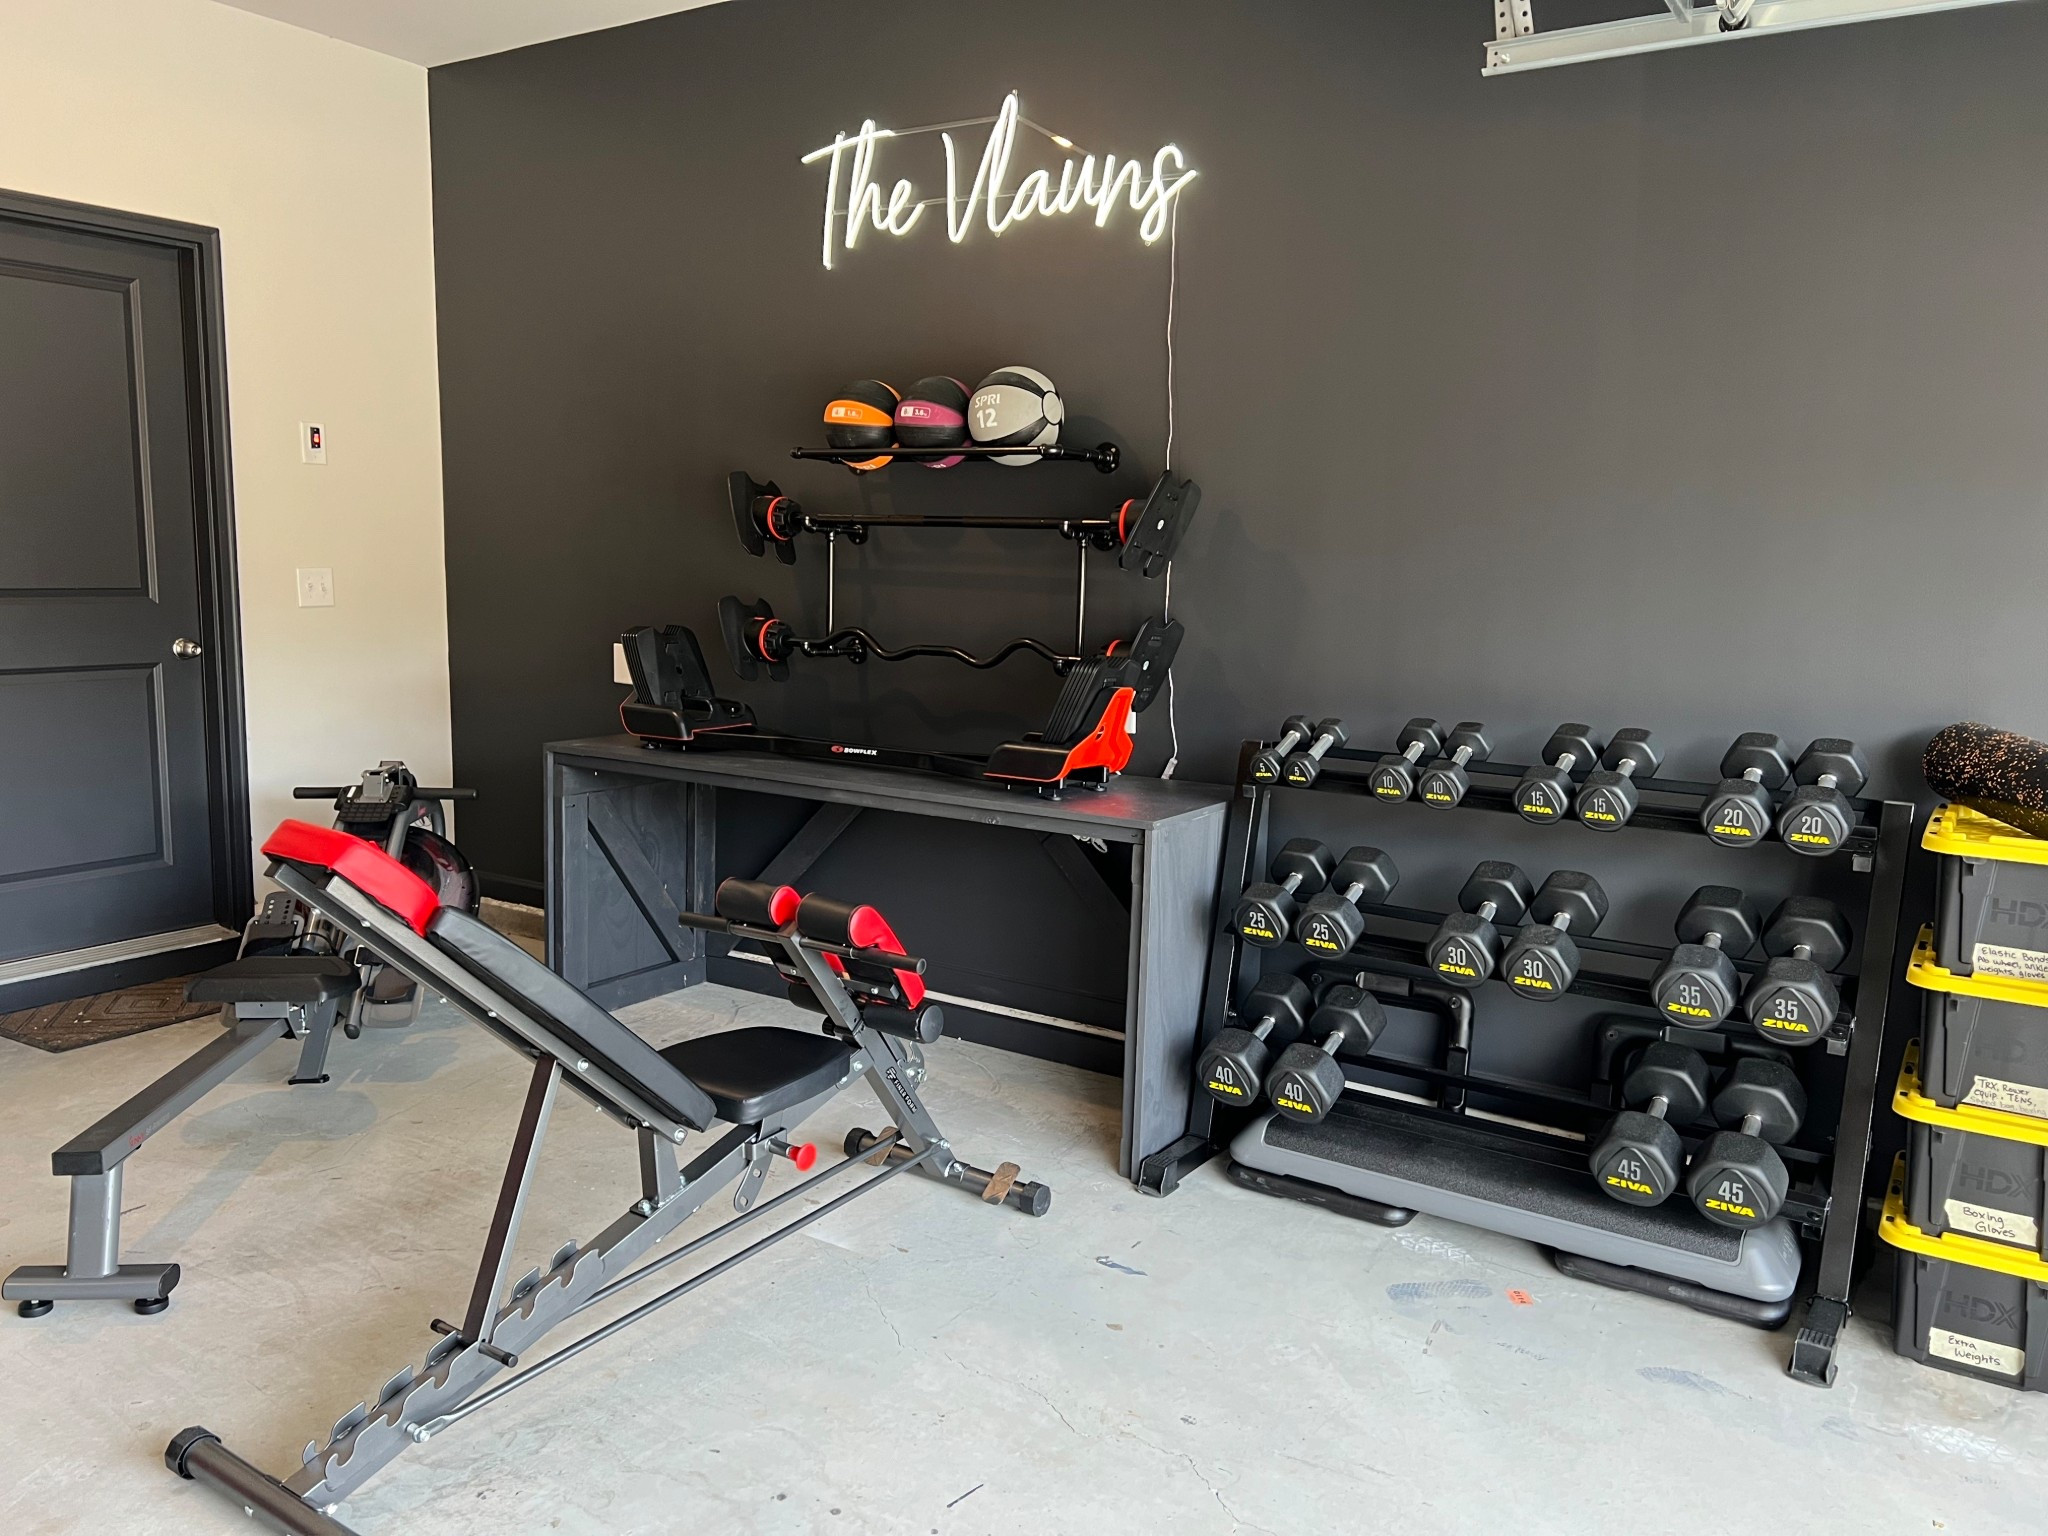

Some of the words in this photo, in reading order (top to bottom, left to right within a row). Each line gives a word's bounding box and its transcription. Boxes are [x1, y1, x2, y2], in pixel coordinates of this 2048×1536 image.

[801, 119, 925, 269] The
[975, 393, 1001, 409] SPRI
[976, 408, 998, 429] 12
[844, 747, 878, 756] BOWFLEX
[1259, 762, 1266, 773] 5
[1294, 766, 1300, 777] 5
[1382, 775, 1394, 788] 10
[1432, 781, 1443, 794] 10
[1376, 787, 1401, 796] ZIVA
[1425, 793, 1452, 802] ZIVA
[1531, 790, 1544, 805] 15
[1523, 804, 1553, 815] ZIVA
[1593, 798, 1606, 812] 15
[1584, 811, 1616, 822] ZIVA
[1724, 809, 1743, 827] 20
[1713, 825, 1752, 837] ZIVA
[1801, 816, 1822, 836] 20
[1790, 833, 1831, 845] ZIVA
[1249, 912, 1266, 929] 25
[1243, 927, 1274, 939] ZIVA
[1312, 922, 1329, 941] 25
[1305, 938, 1338, 951] ZIVA
[1447, 946, 1466, 966] 30
[1981, 947, 2016, 959] Elastic
[1438, 963, 1476, 977] ZIVA
[1523, 958, 1543, 979] 30
[2019, 970, 2046, 978] gloves
[1513, 976, 1552, 990] ZIVA
[1679, 984, 1701, 1007] 35
[1666, 1002, 1712, 1018] ZIVA
[1774, 998, 1798, 1021] 35
[1762, 1017, 1810, 1033] ZIVA
[1215, 1065, 1233, 1085] 40
[1208, 1081, 1243, 1096] ZIVA
[1284, 1082, 1303, 1102] 40
[1277, 1098, 1313, 1114] ZIVA
[1617, 1159, 1641, 1181] 45
[1606, 1176, 1653, 1195] ZIVA
[1960, 1162, 2038, 1199] HDX
[1718, 1180, 1744, 1204] 45
[1705, 1198, 1756, 1218] ZIVA
[1963, 1206, 2005, 1229] Boxing
[1975, 1221, 2016, 1238] Gloves
[1944, 1290, 2018, 1330] HDX
[1948, 1335, 1977, 1350] Extra
